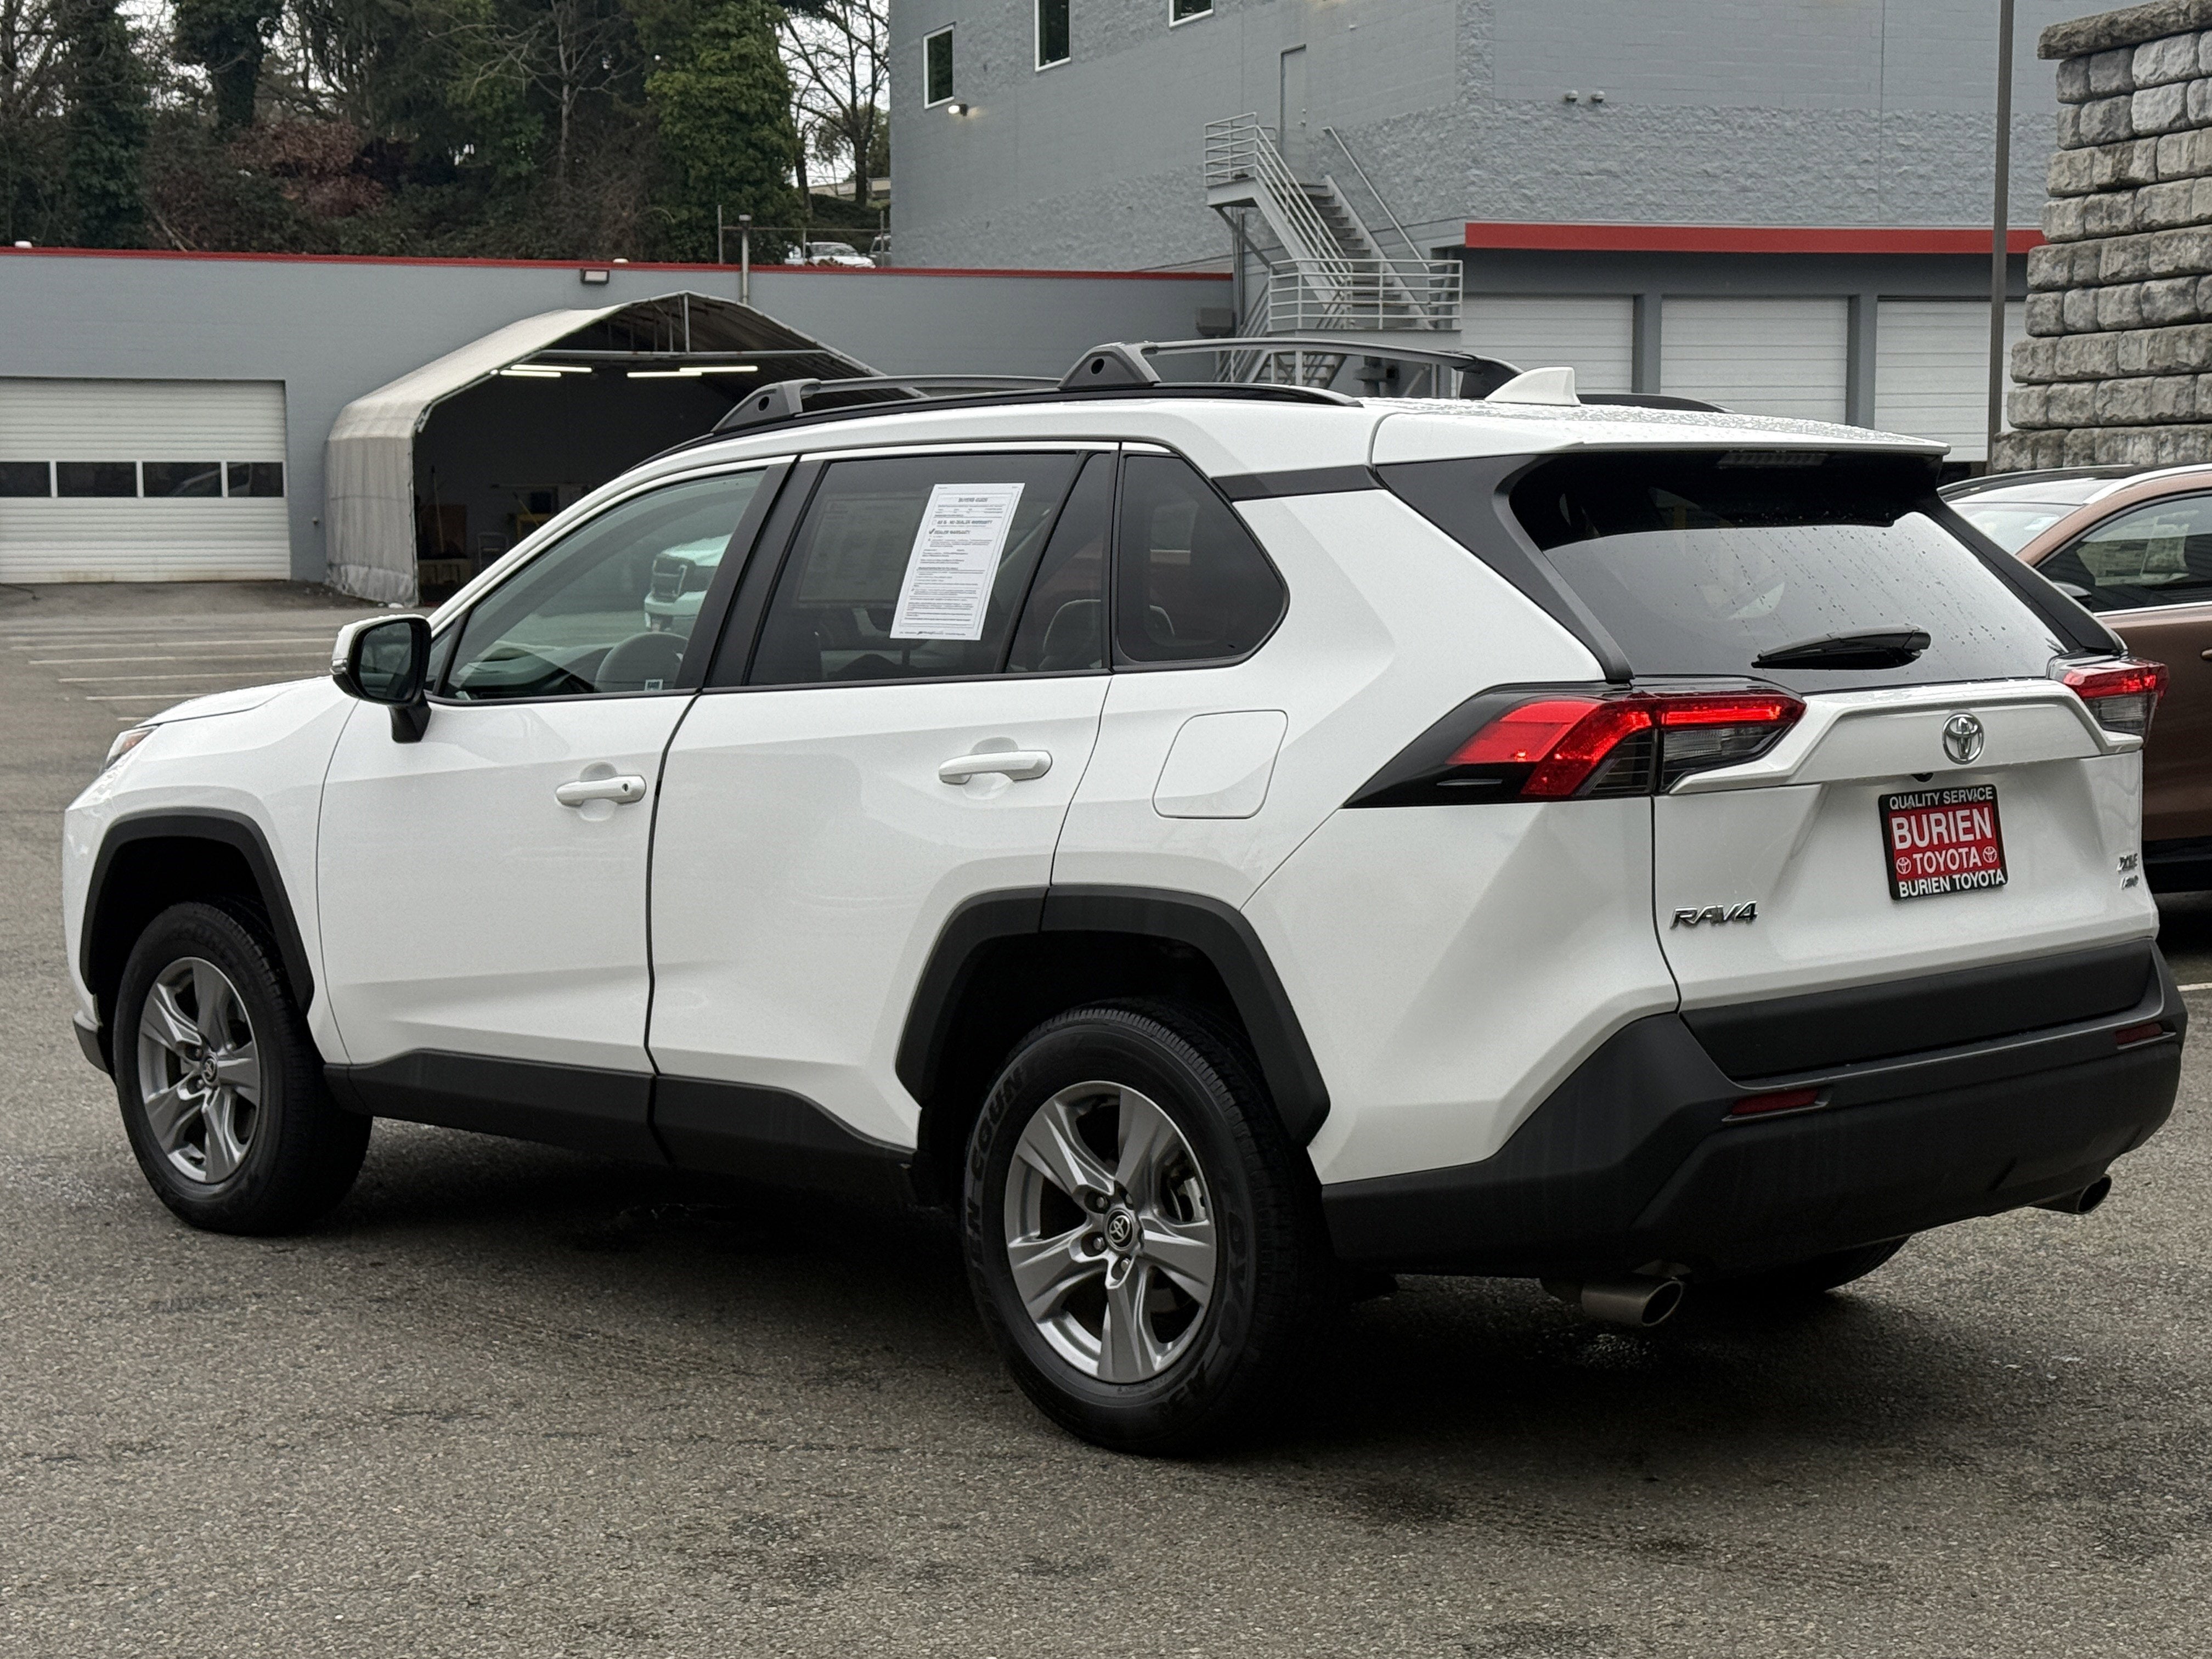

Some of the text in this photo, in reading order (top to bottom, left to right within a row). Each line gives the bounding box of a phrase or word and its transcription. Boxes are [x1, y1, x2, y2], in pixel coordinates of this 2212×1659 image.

[1889, 787, 1994, 810] QUALITY SERVICE
[1892, 807, 1993, 850] BURIEN
[1912, 847, 1982, 874] TOYOTA
[1899, 869, 2006, 898] BURIEN TOYOTA
[1669, 900, 1758, 929] RAV4
